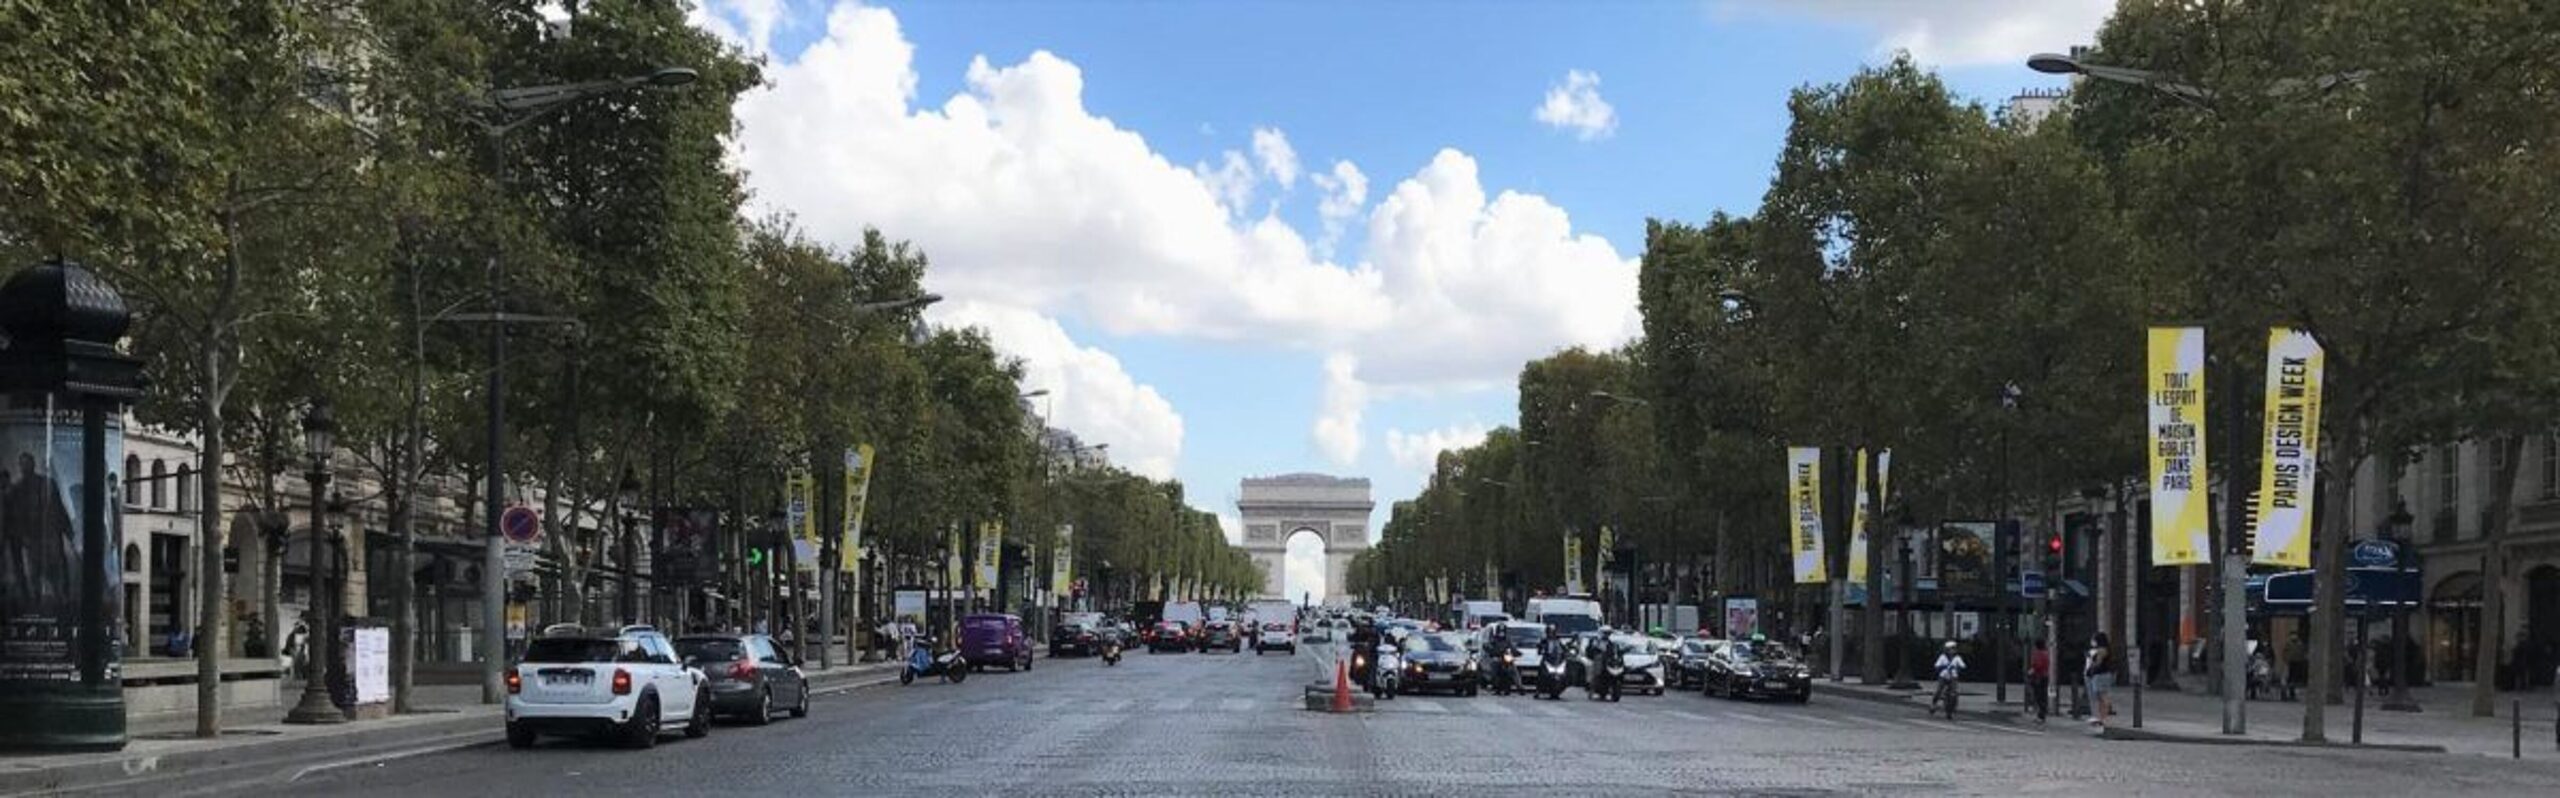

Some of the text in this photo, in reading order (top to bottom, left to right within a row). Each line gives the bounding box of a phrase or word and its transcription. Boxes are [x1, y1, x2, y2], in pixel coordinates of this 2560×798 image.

[2163, 372, 2189, 388] TOUT
[2156, 389, 2197, 406] LESPRIT
[2169, 407, 2183, 423] DE
[2158, 424, 2196, 440] MAISON
[2272, 356, 2307, 509] PARIS DESIGN WEEK
[2164, 458, 2191, 474] DANS
[2163, 475, 2193, 491] PARIS
